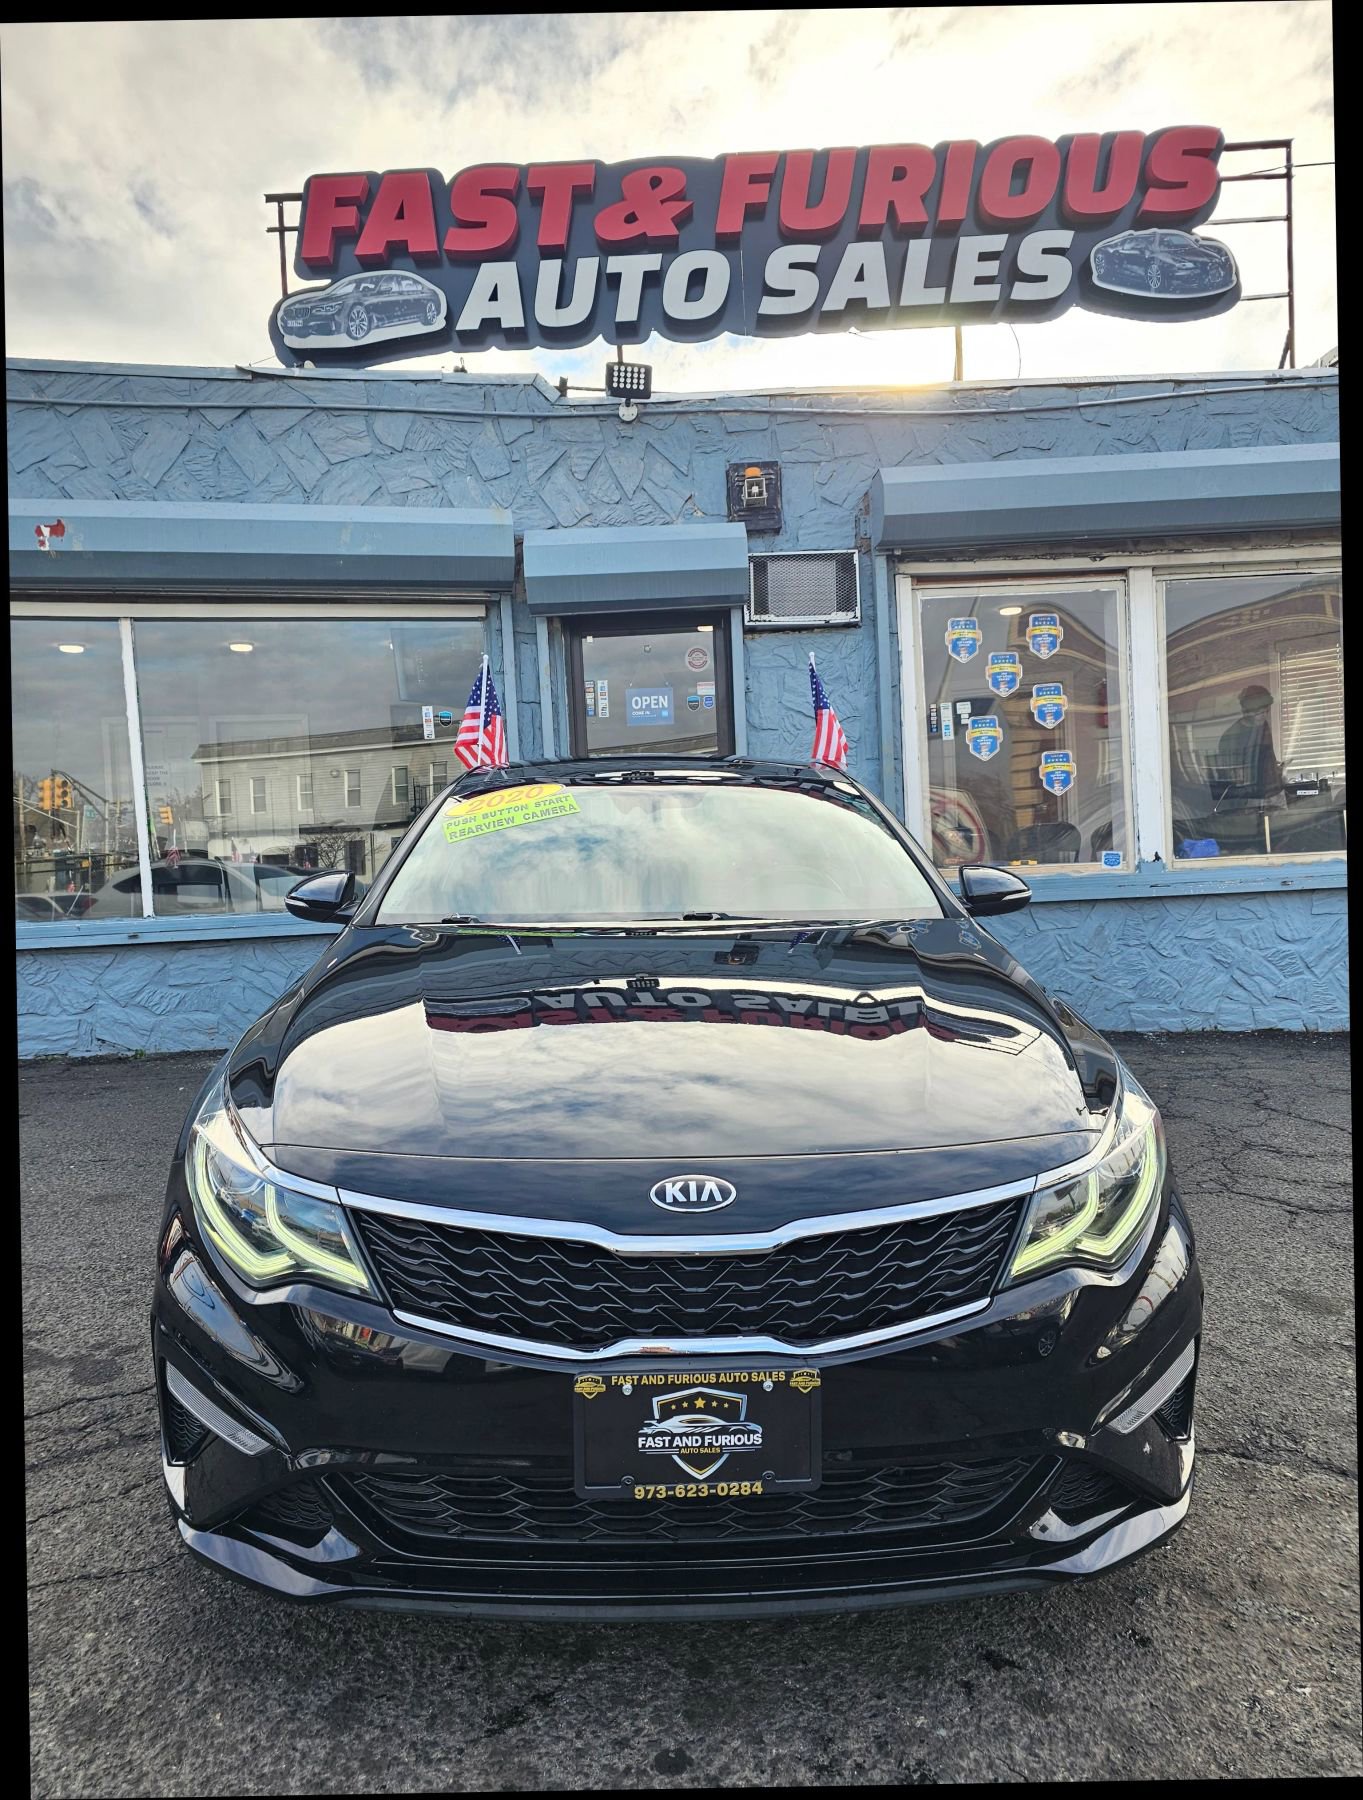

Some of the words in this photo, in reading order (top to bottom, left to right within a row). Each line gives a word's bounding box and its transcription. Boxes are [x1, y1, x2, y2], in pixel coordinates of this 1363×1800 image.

[301, 163, 596, 265] FAST
[593, 166, 694, 247] &
[715, 125, 1222, 242] FURIOUS
[455, 249, 731, 333] AUTO
[757, 229, 1076, 317] SALES
[631, 695, 668, 709] OPEN
[465, 786, 544, 812] 2020
[446, 815, 477, 830] PUSH
[482, 803, 529, 820] BUTTON
[534, 794, 571, 808] START
[448, 816, 516, 840] REARVIEW
[522, 803, 577, 821] CAMERA
[664, 1181, 723, 1203] KIA
[611, 1375, 639, 1386] FAST
[641, 1374, 665, 1385] AND
[667, 1373, 717, 1385] FURIOUS
[719, 1372, 749, 1383] AUTO
[751, 1371, 786, 1382] SALES
[638, 1436, 671, 1448] FAST
[673, 1435, 700, 1447] AND
[704, 1433, 763, 1447] FURIOUS
[634, 1480, 763, 1499] 973-623-0284
